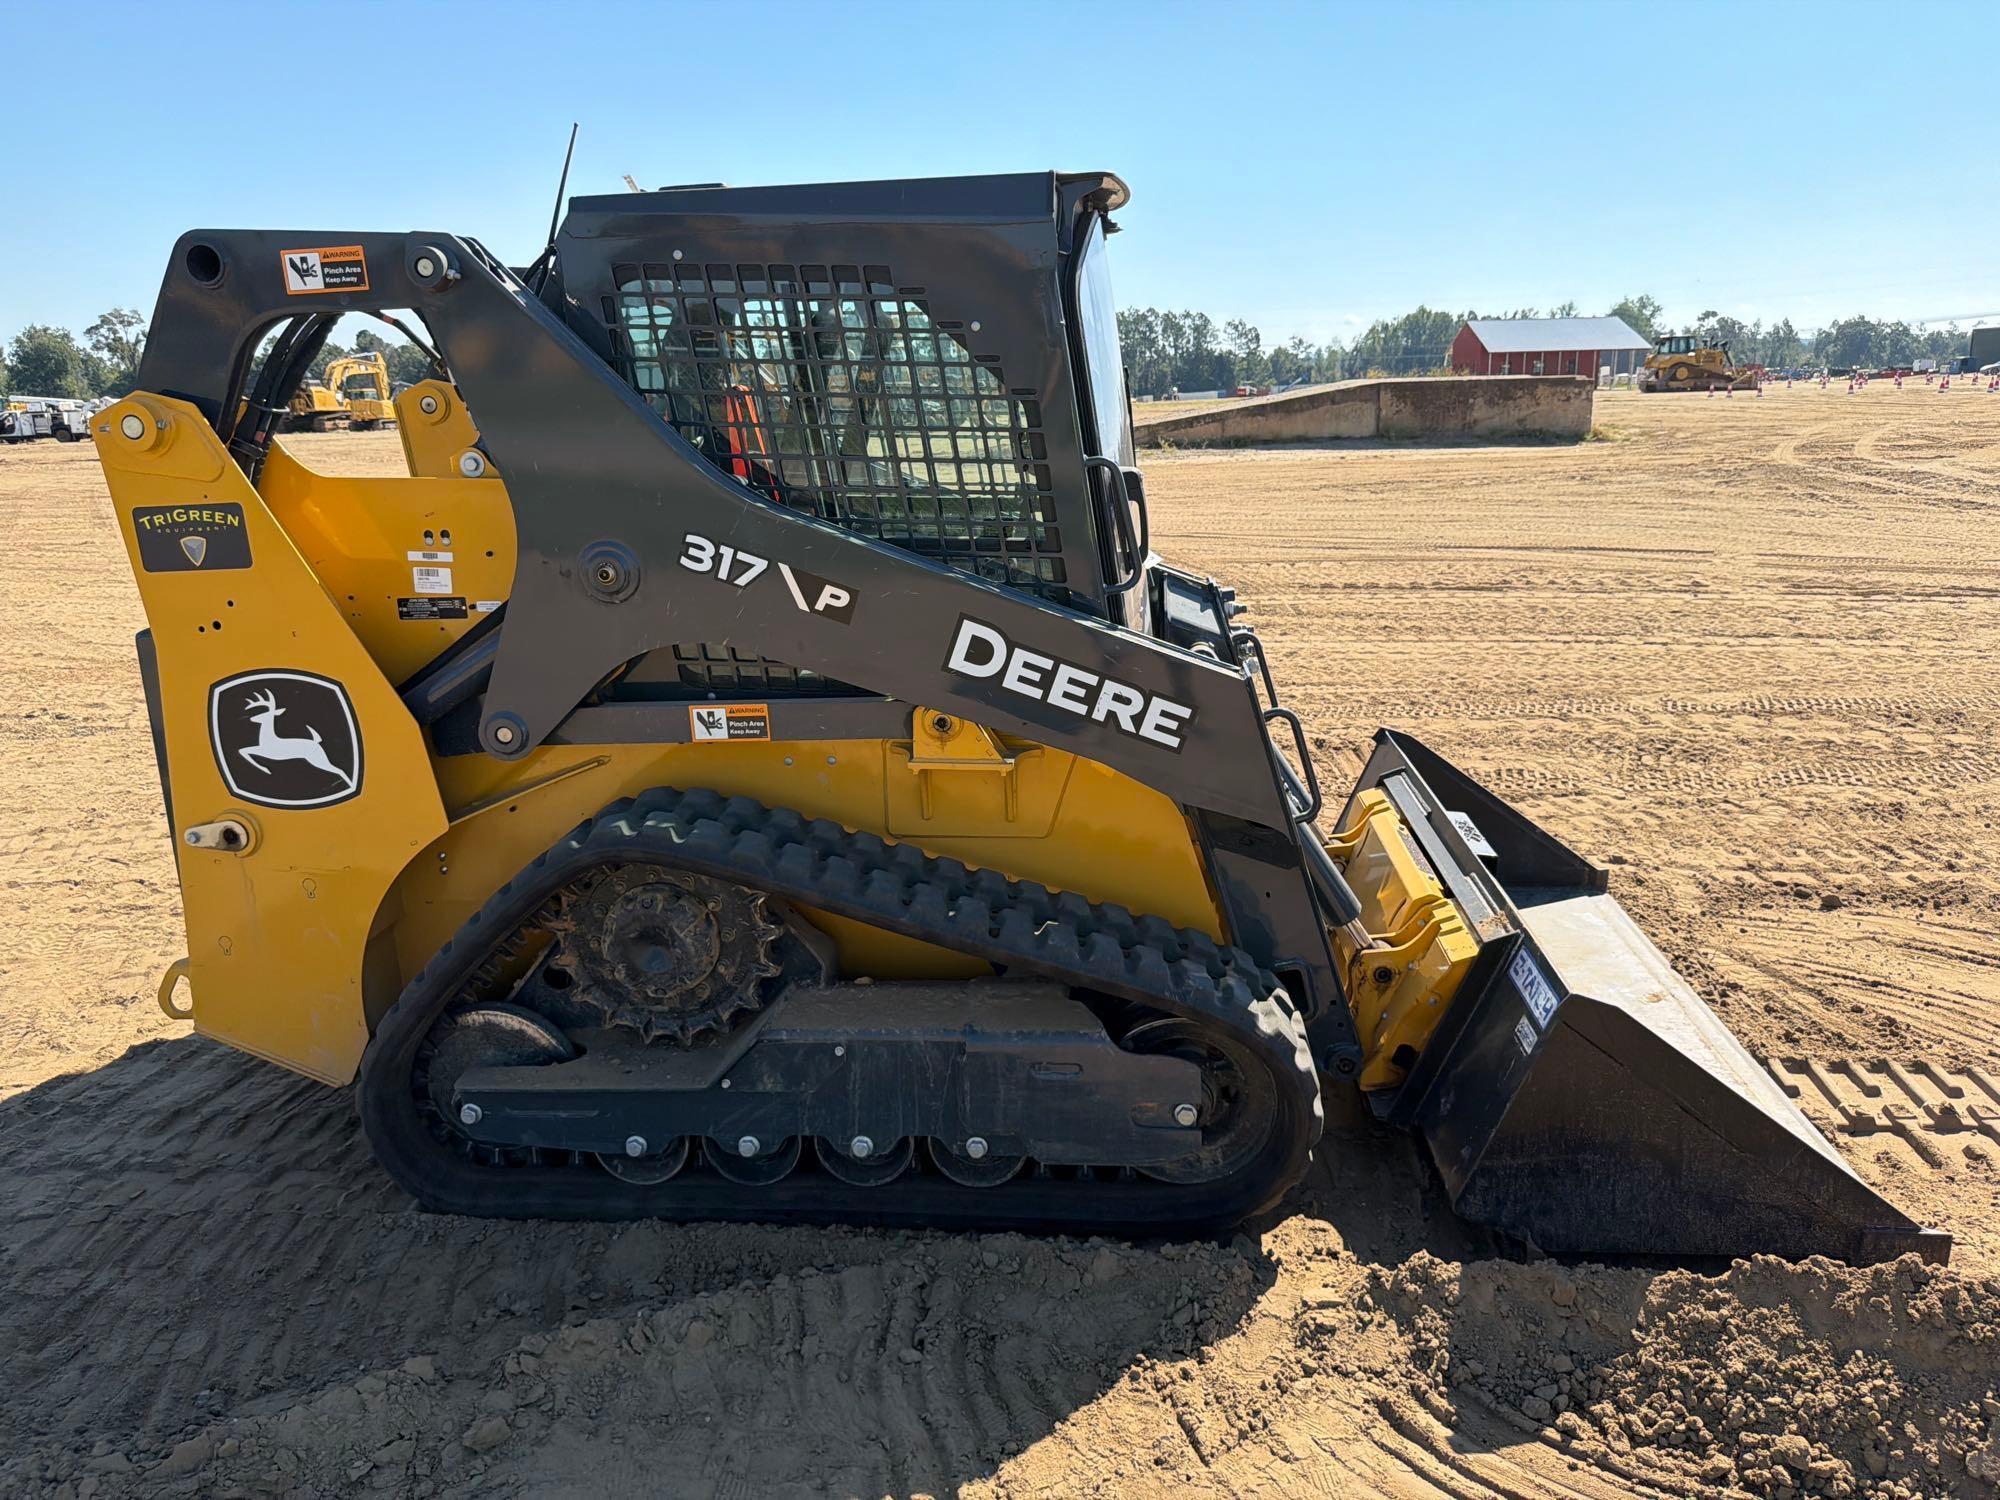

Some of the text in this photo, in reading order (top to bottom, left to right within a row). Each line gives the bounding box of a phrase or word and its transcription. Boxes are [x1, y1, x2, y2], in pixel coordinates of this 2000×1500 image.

[329, 250, 360, 258] WARNING
[139, 509, 239, 530] TRIGREEN
[157, 525, 227, 533] EQUIPMENT
[680, 534, 769, 586] 317
[948, 619, 1192, 748] DEERE
